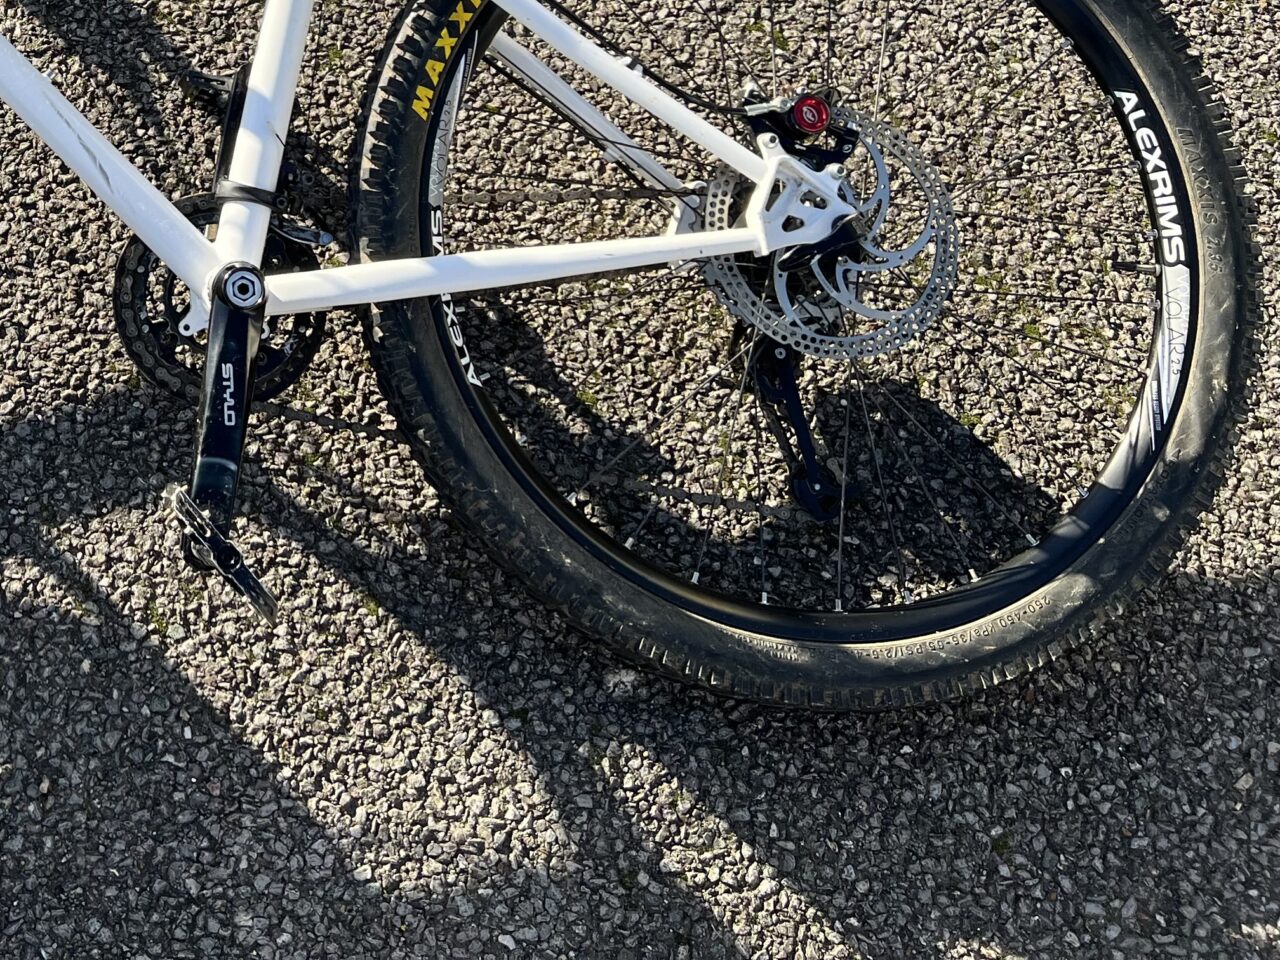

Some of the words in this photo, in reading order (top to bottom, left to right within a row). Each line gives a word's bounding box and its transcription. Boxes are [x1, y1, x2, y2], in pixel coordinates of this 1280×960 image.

[436, 119, 451, 185] VOLAR
[444, 99, 452, 115] 2.5
[1112, 91, 1189, 265] ALEXRIMS
[1175, 128, 1219, 227] MAXXIS
[1164, 286, 1186, 354] VOLAR
[221, 363, 237, 426] STYLO
[1170, 359, 1181, 375] 2.5
